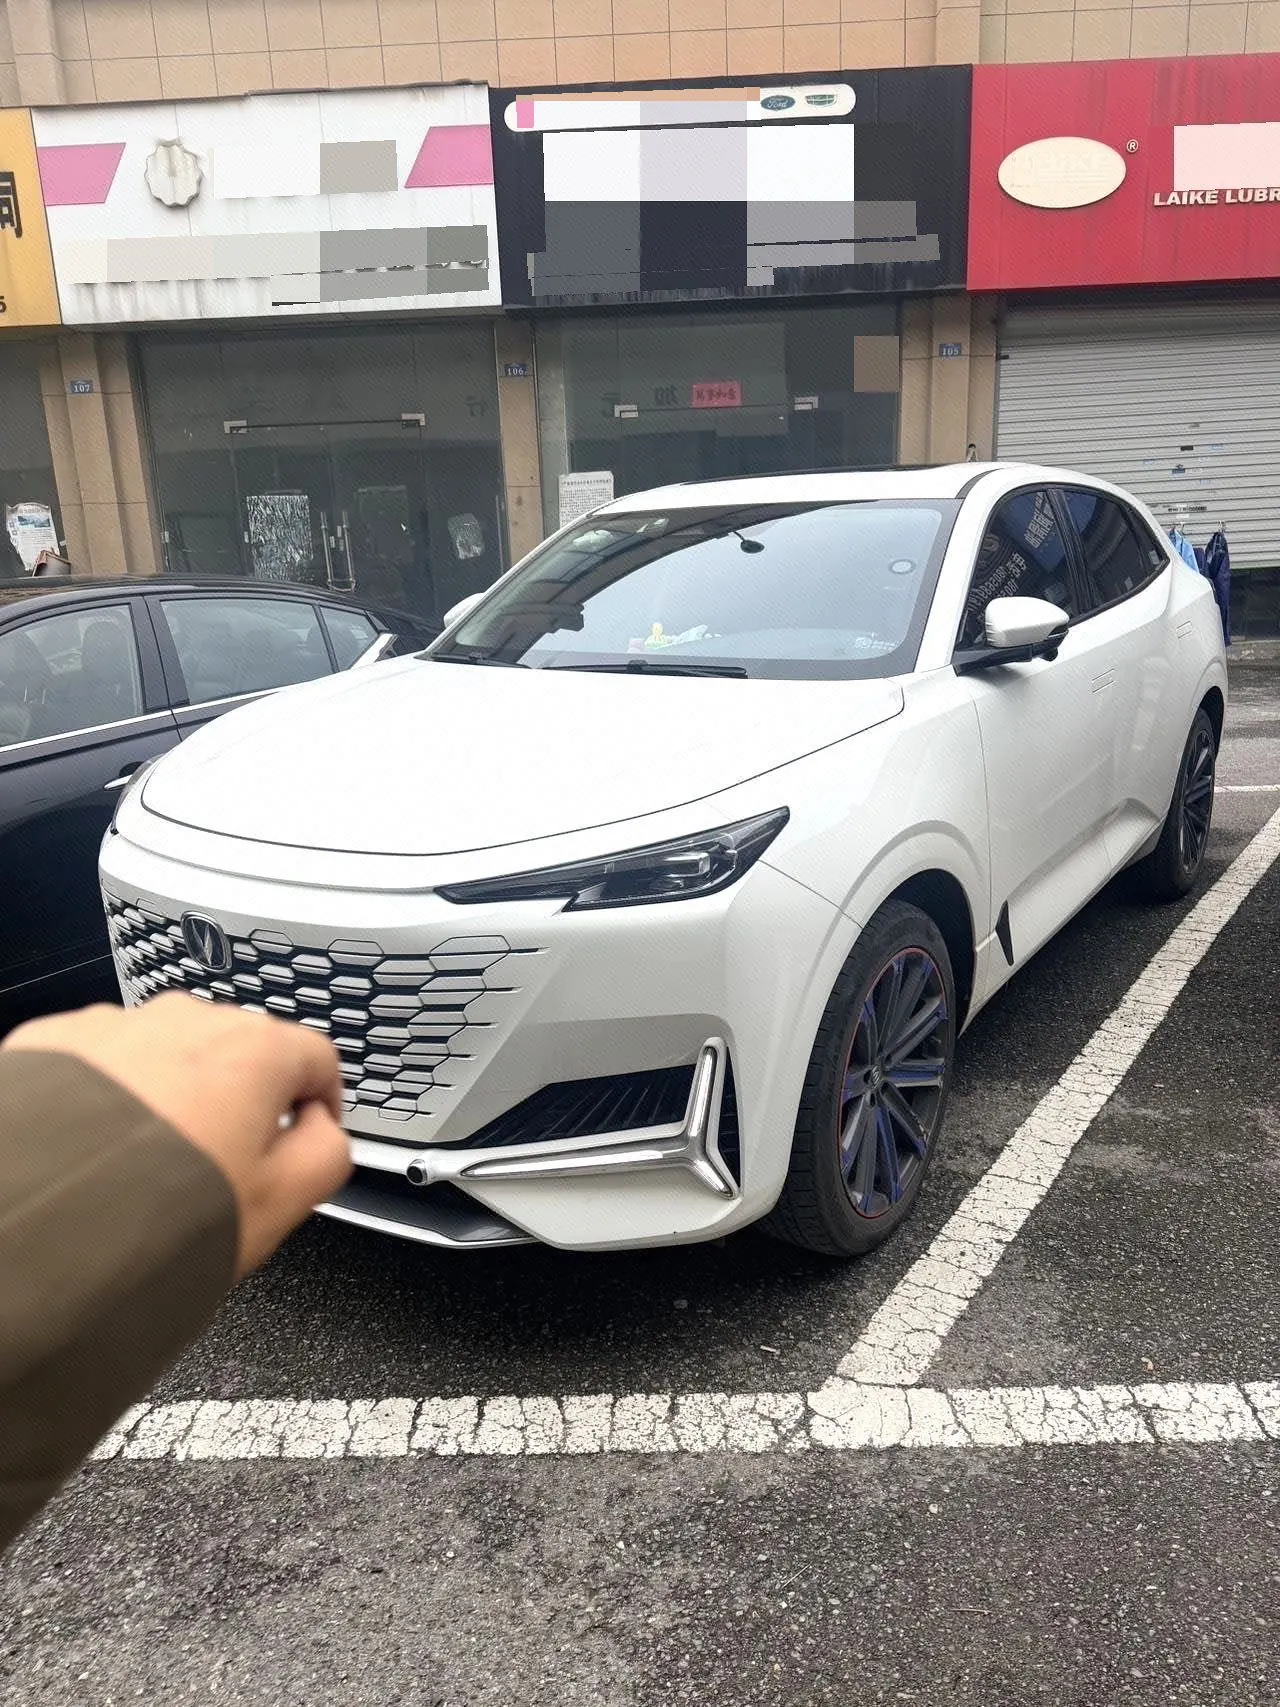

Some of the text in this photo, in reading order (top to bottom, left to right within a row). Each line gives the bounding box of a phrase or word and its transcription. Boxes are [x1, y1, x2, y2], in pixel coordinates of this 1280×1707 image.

[1153, 187, 1280, 206] LAIKE LUBR
[507, 367, 524, 376] 106
[74, 383, 91, 393] 107
